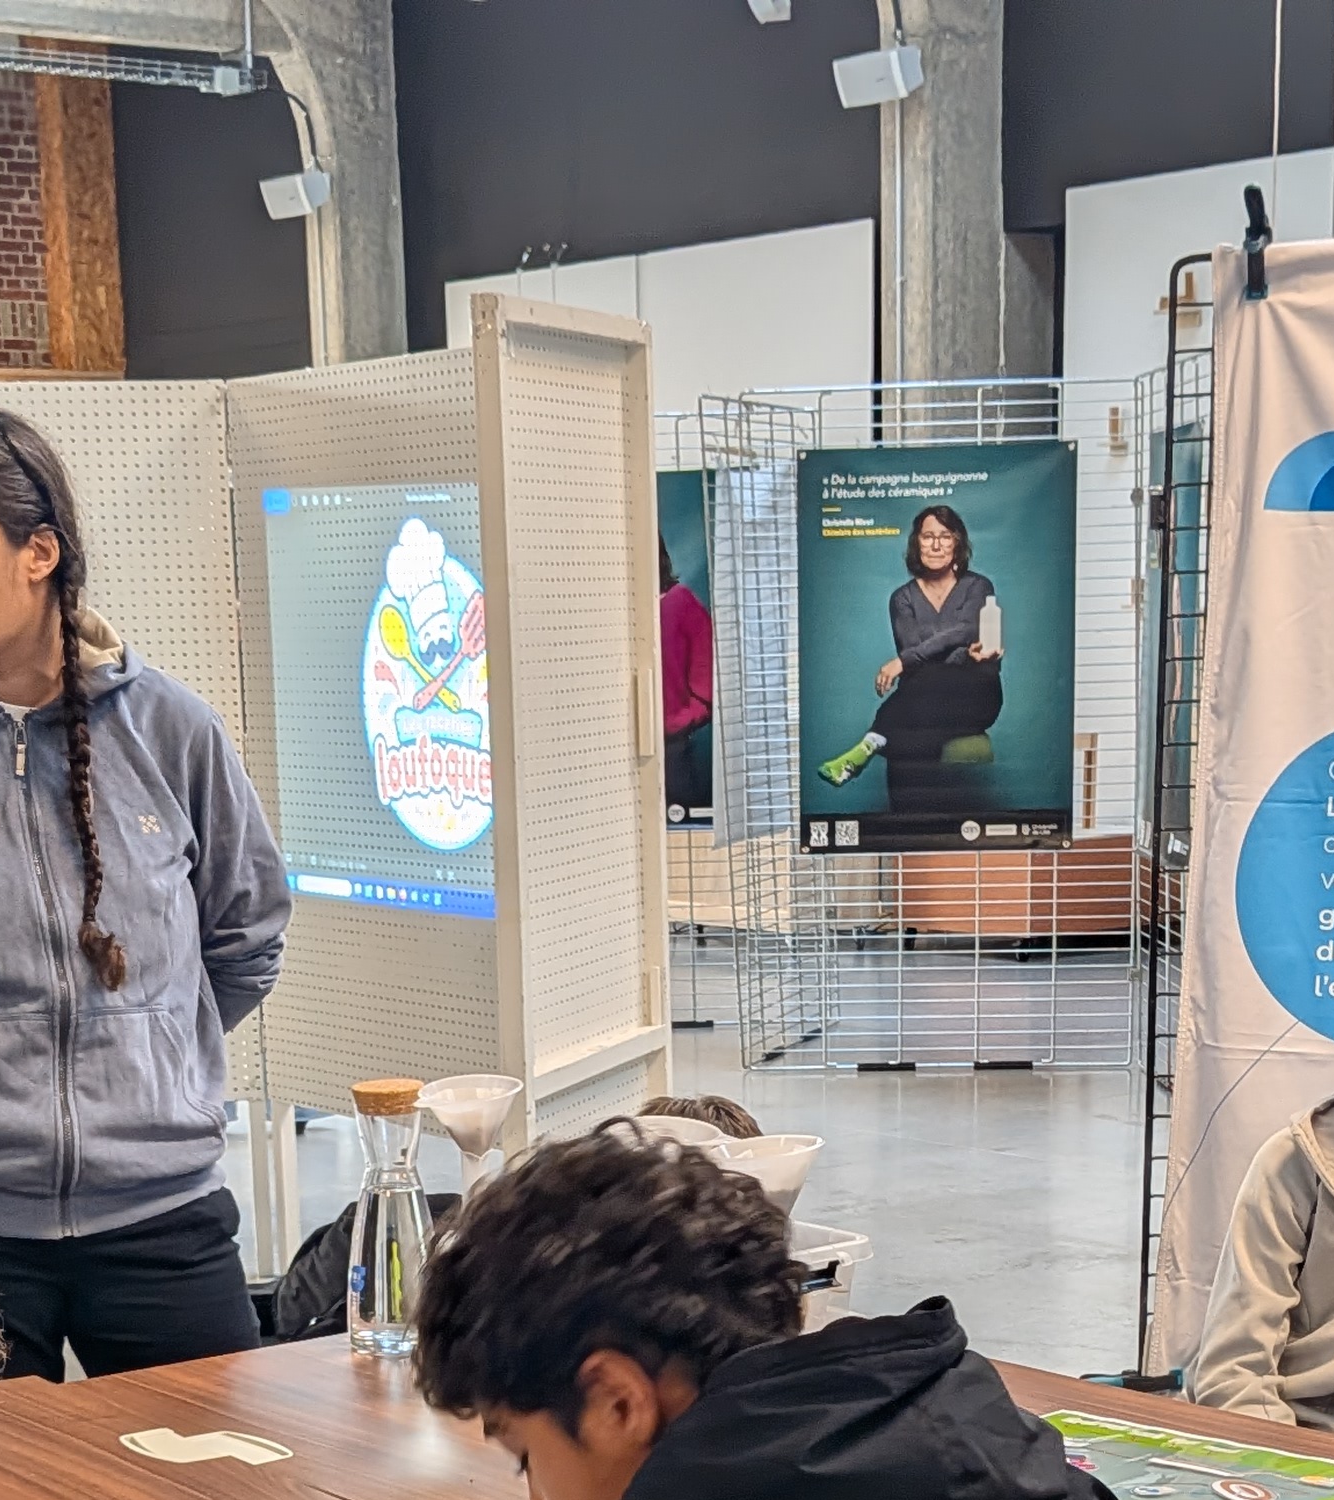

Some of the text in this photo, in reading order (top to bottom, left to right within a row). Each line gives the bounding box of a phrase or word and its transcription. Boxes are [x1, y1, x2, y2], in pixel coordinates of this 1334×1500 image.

[858, 474, 910, 487] campagne
[868, 486, 886, 498] des
[888, 485, 945, 498] céramiques
